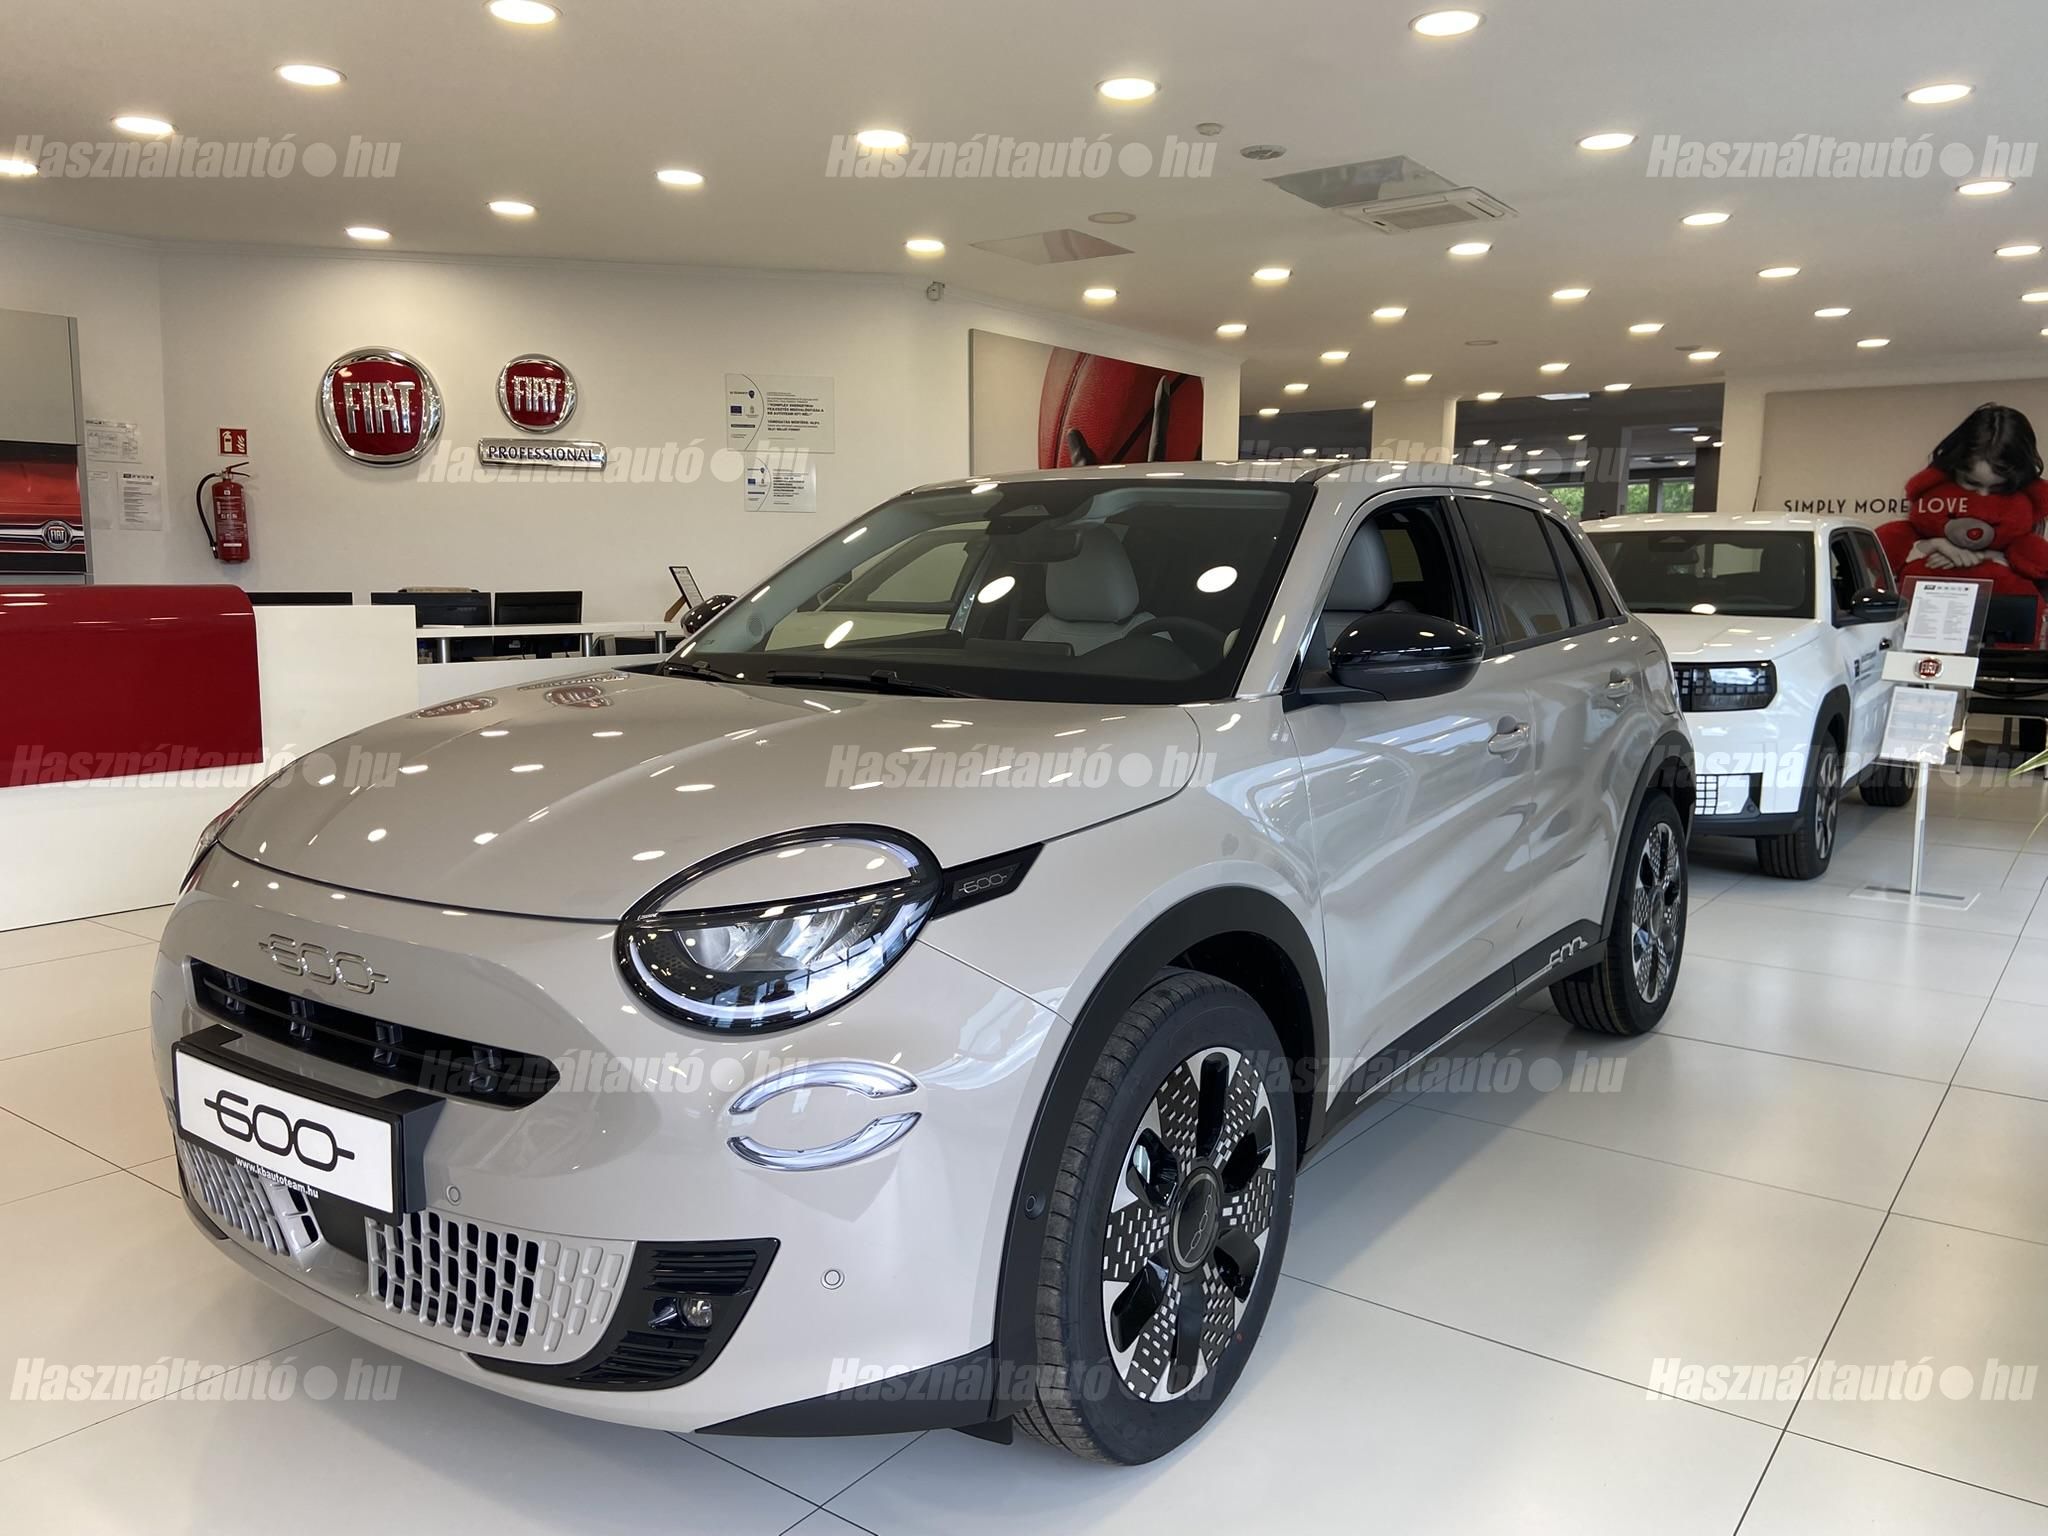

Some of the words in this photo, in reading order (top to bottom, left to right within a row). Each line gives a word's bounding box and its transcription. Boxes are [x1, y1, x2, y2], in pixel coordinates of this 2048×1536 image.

[343, 381, 415, 433] FIAT
[513, 375, 561, 412] FIAT
[488, 445, 594, 461] PROFESSIONAL
[1784, 499, 1845, 514] SIMPLY
[1855, 498, 1910, 514] MORE
[1918, 497, 1968, 513] LOVE
[49, 525, 66, 544] FIAT
[214, 1089, 340, 1172] 600
[235, 1157, 319, 1199] www.kbautoteam.hu
